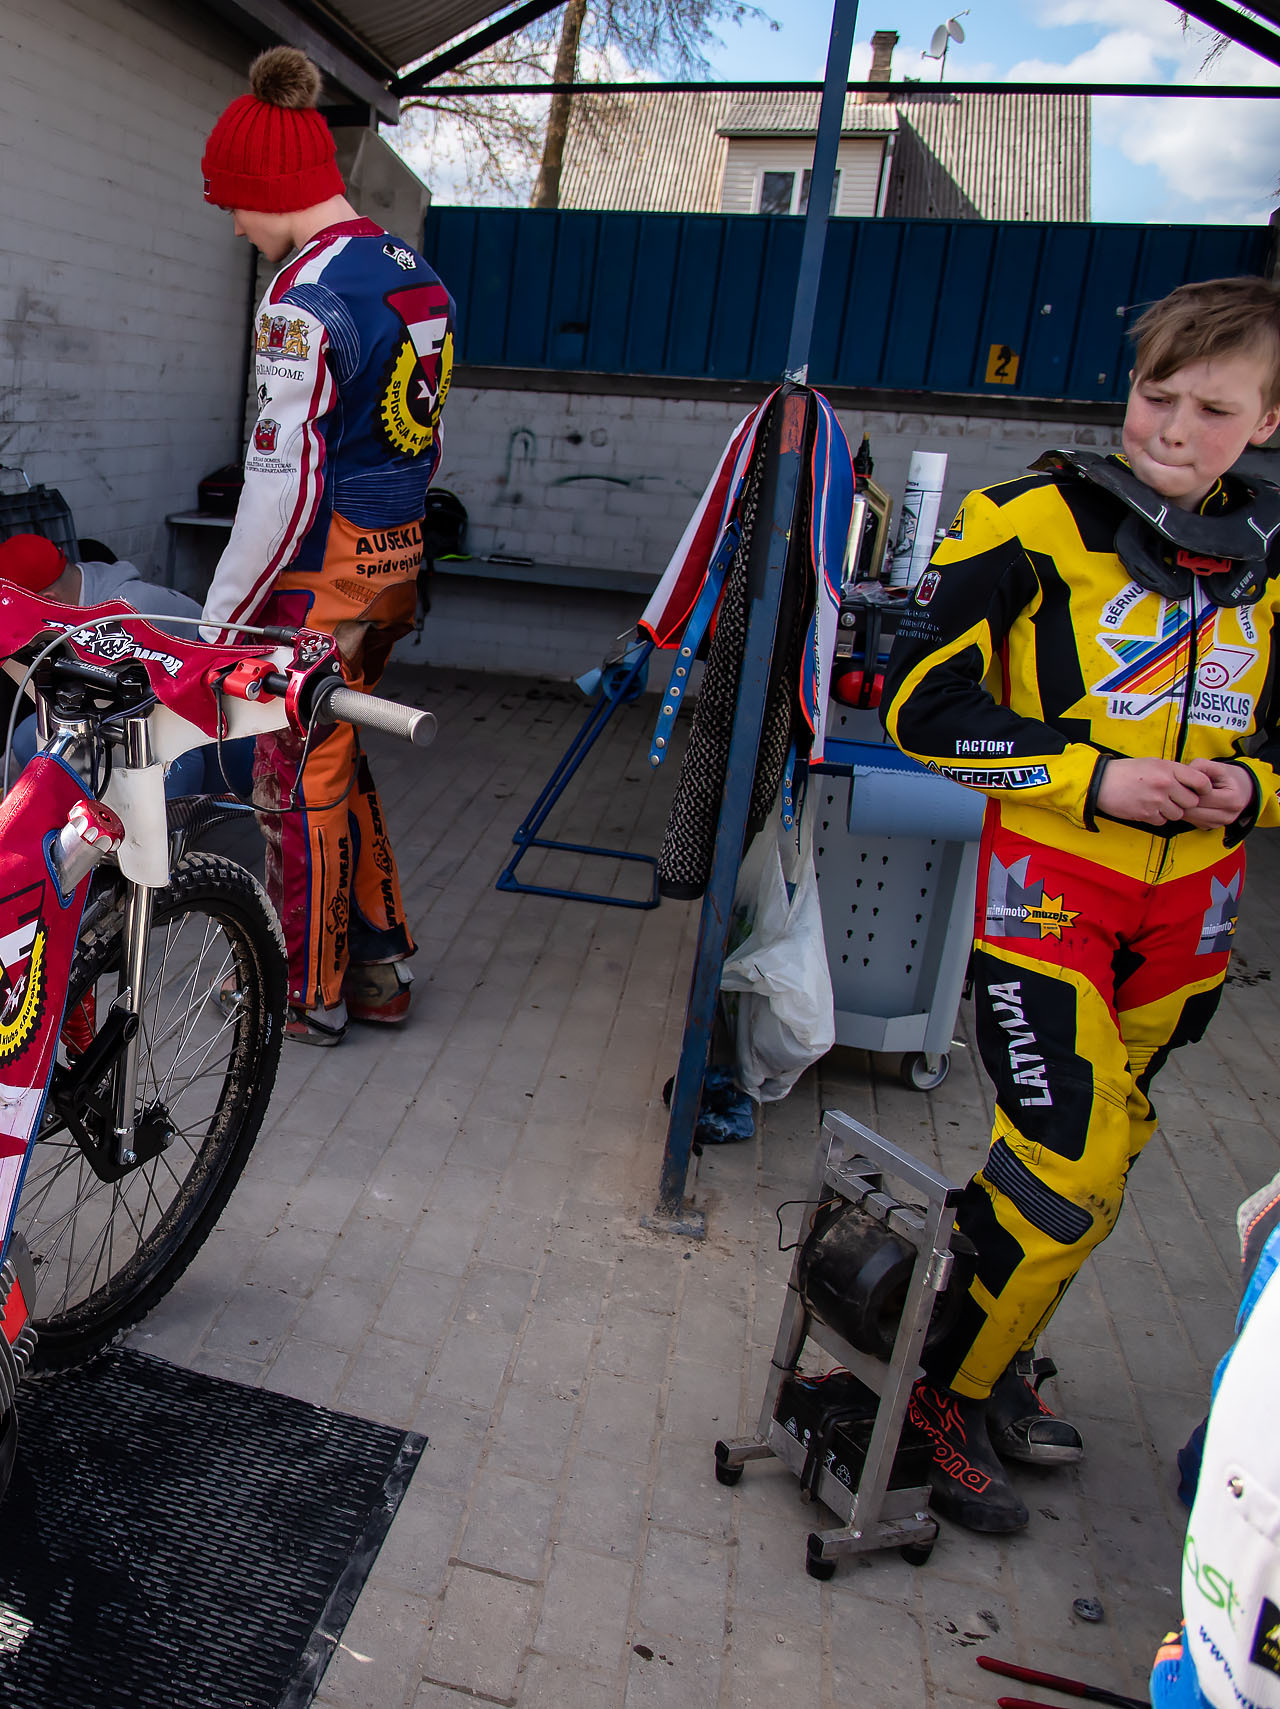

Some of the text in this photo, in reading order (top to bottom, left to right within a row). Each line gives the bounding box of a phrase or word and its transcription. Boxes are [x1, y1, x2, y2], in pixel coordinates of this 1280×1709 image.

[994, 345, 1012, 377] 2
[271, 366, 304, 381] DOME
[1225, 716, 1247, 728] 1989
[955, 739, 1015, 755] FACTORY
[986, 980, 1054, 1107] LATVIJA
